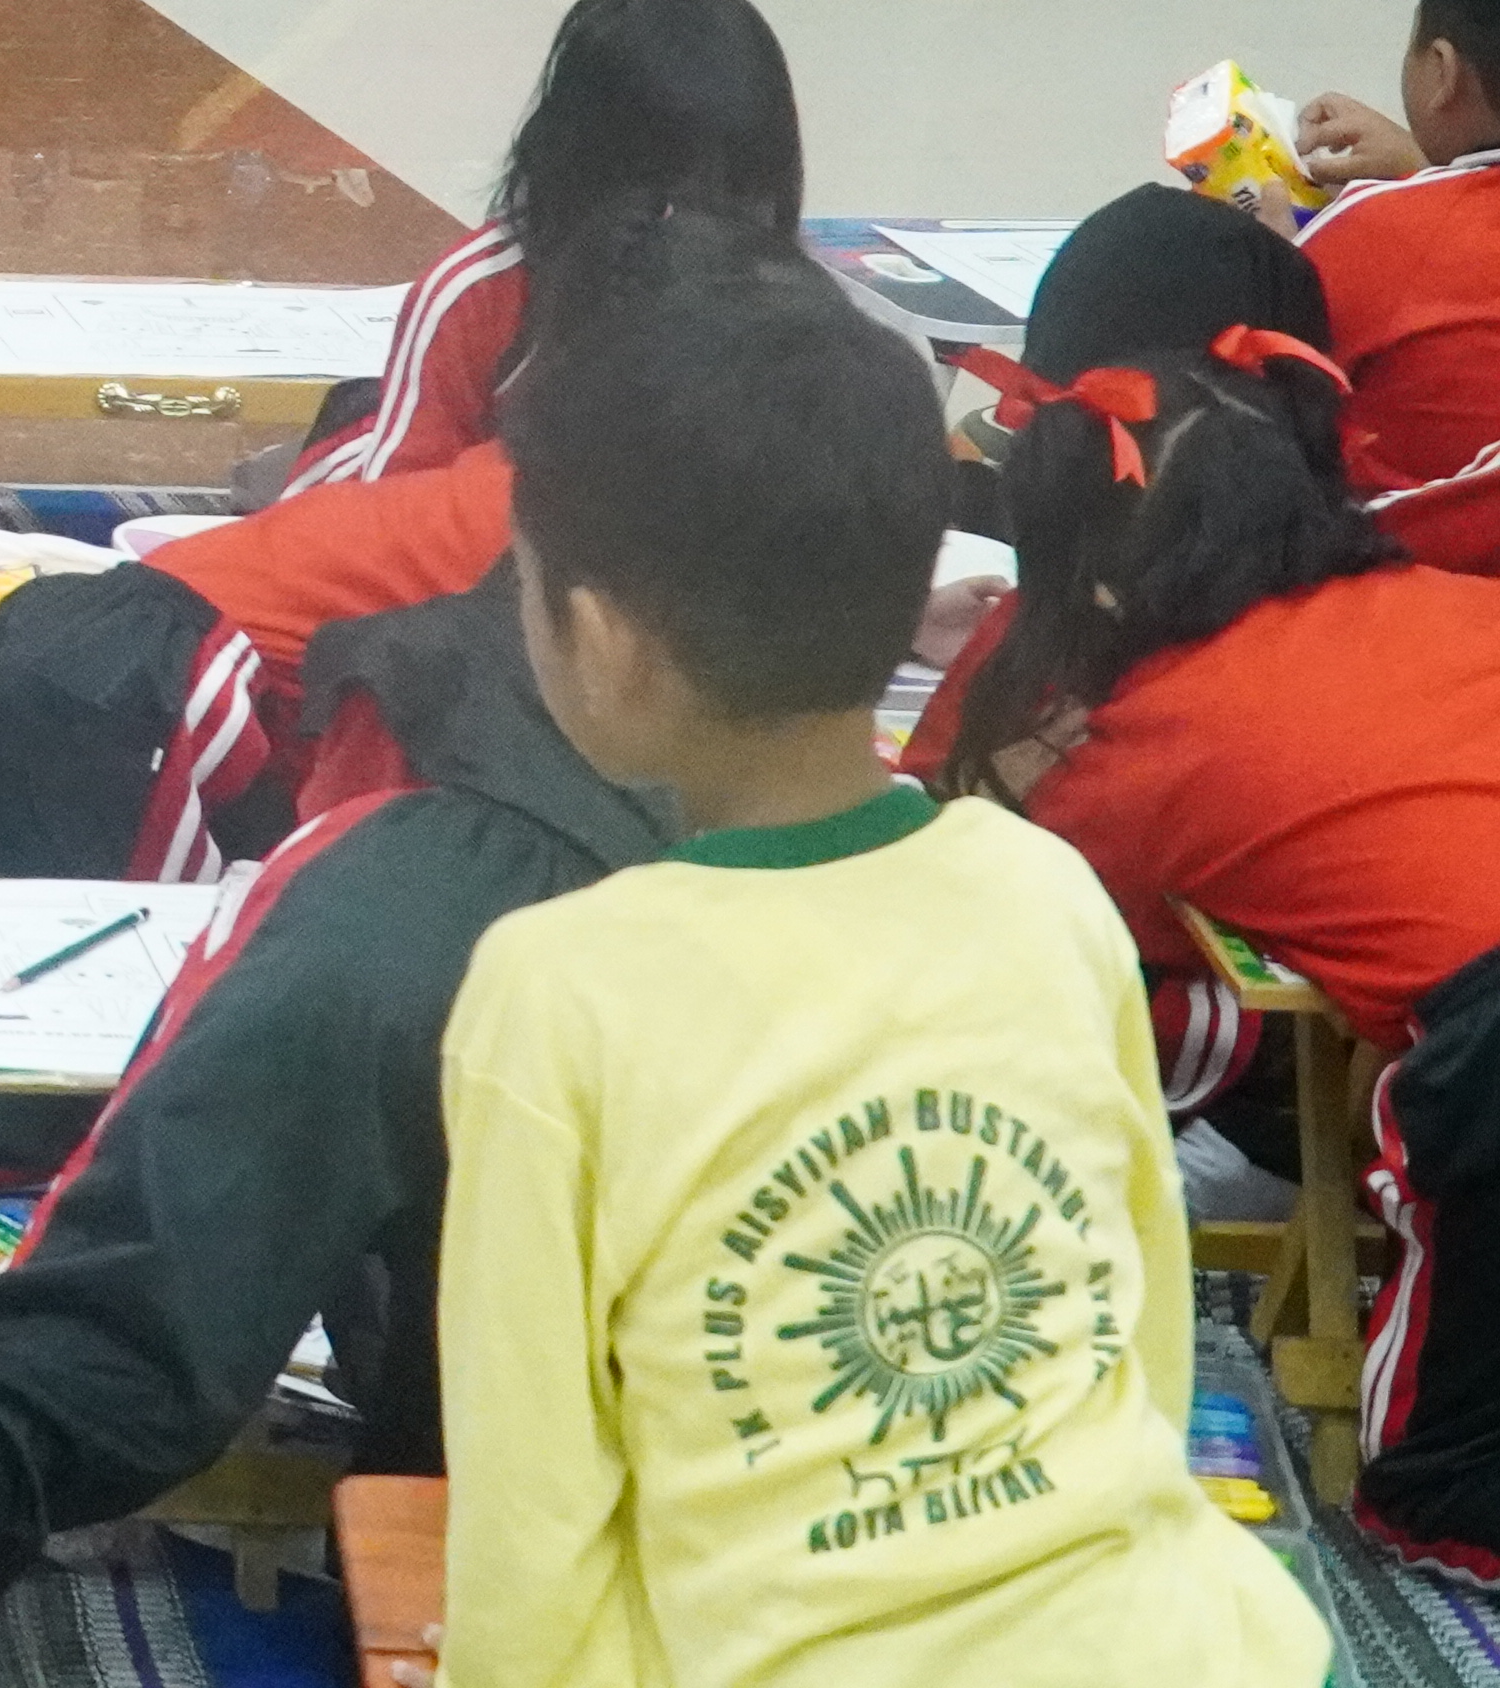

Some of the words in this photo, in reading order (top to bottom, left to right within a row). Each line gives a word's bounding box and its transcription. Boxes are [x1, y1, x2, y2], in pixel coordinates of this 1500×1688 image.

[721, 1096, 892, 1264] AISYIYAH
[704, 1276, 750, 1392] PLUS
[809, 1500, 905, 1554] KOTA
